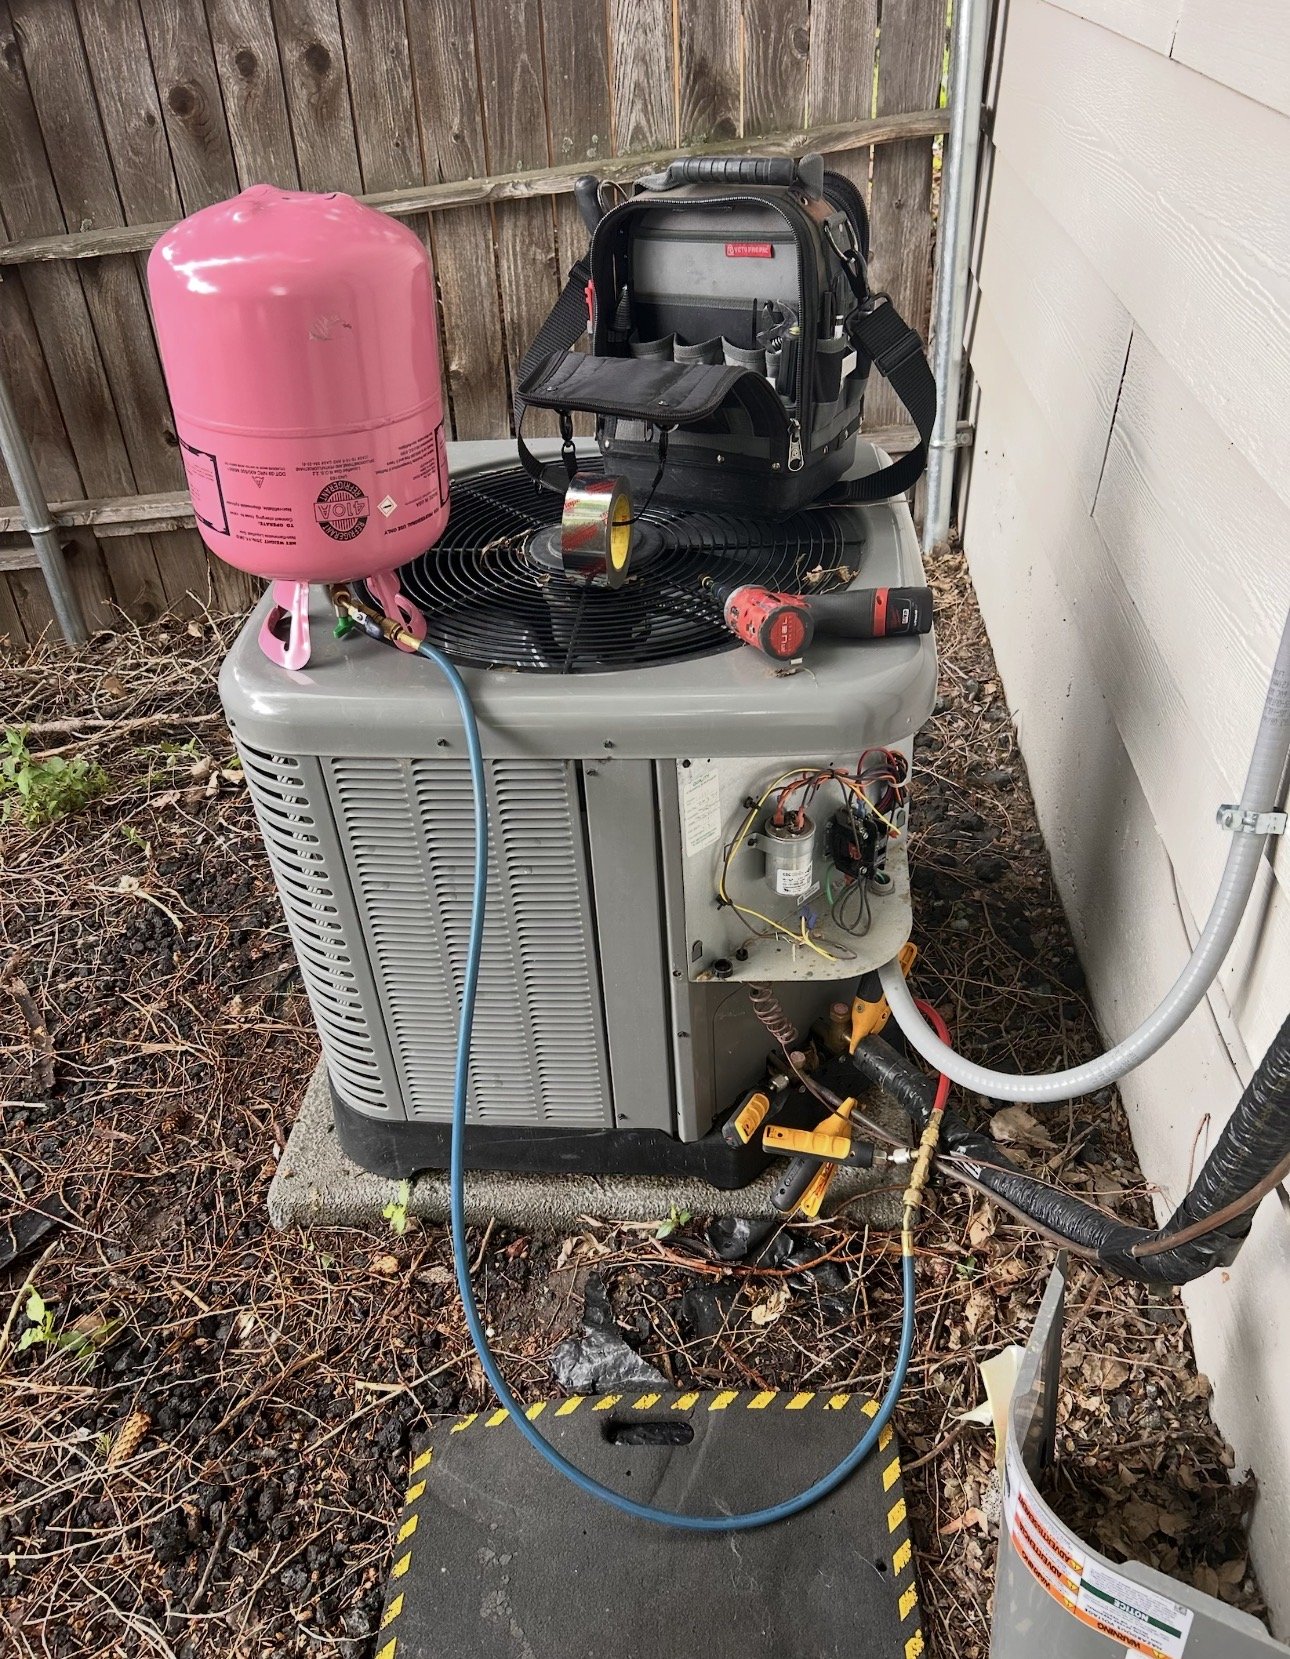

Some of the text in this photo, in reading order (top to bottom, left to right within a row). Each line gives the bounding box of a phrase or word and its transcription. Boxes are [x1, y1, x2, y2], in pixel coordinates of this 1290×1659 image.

[319, 481, 361, 500] REFRIGERANT
[318, 501, 365, 519] 410A
[322, 522, 364, 540] REFRIGERANT
[384, 527, 397, 535] ONLY
[1017, 1494, 1071, 1560] ADVERTISSEMENT
[1018, 1522, 1063, 1577] ADVERTENCIA
[1020, 1551, 1050, 1590] WARNING
[1112, 1599, 1149, 1622] NOTICE
[1096, 1622, 1140, 1649] WARNING
